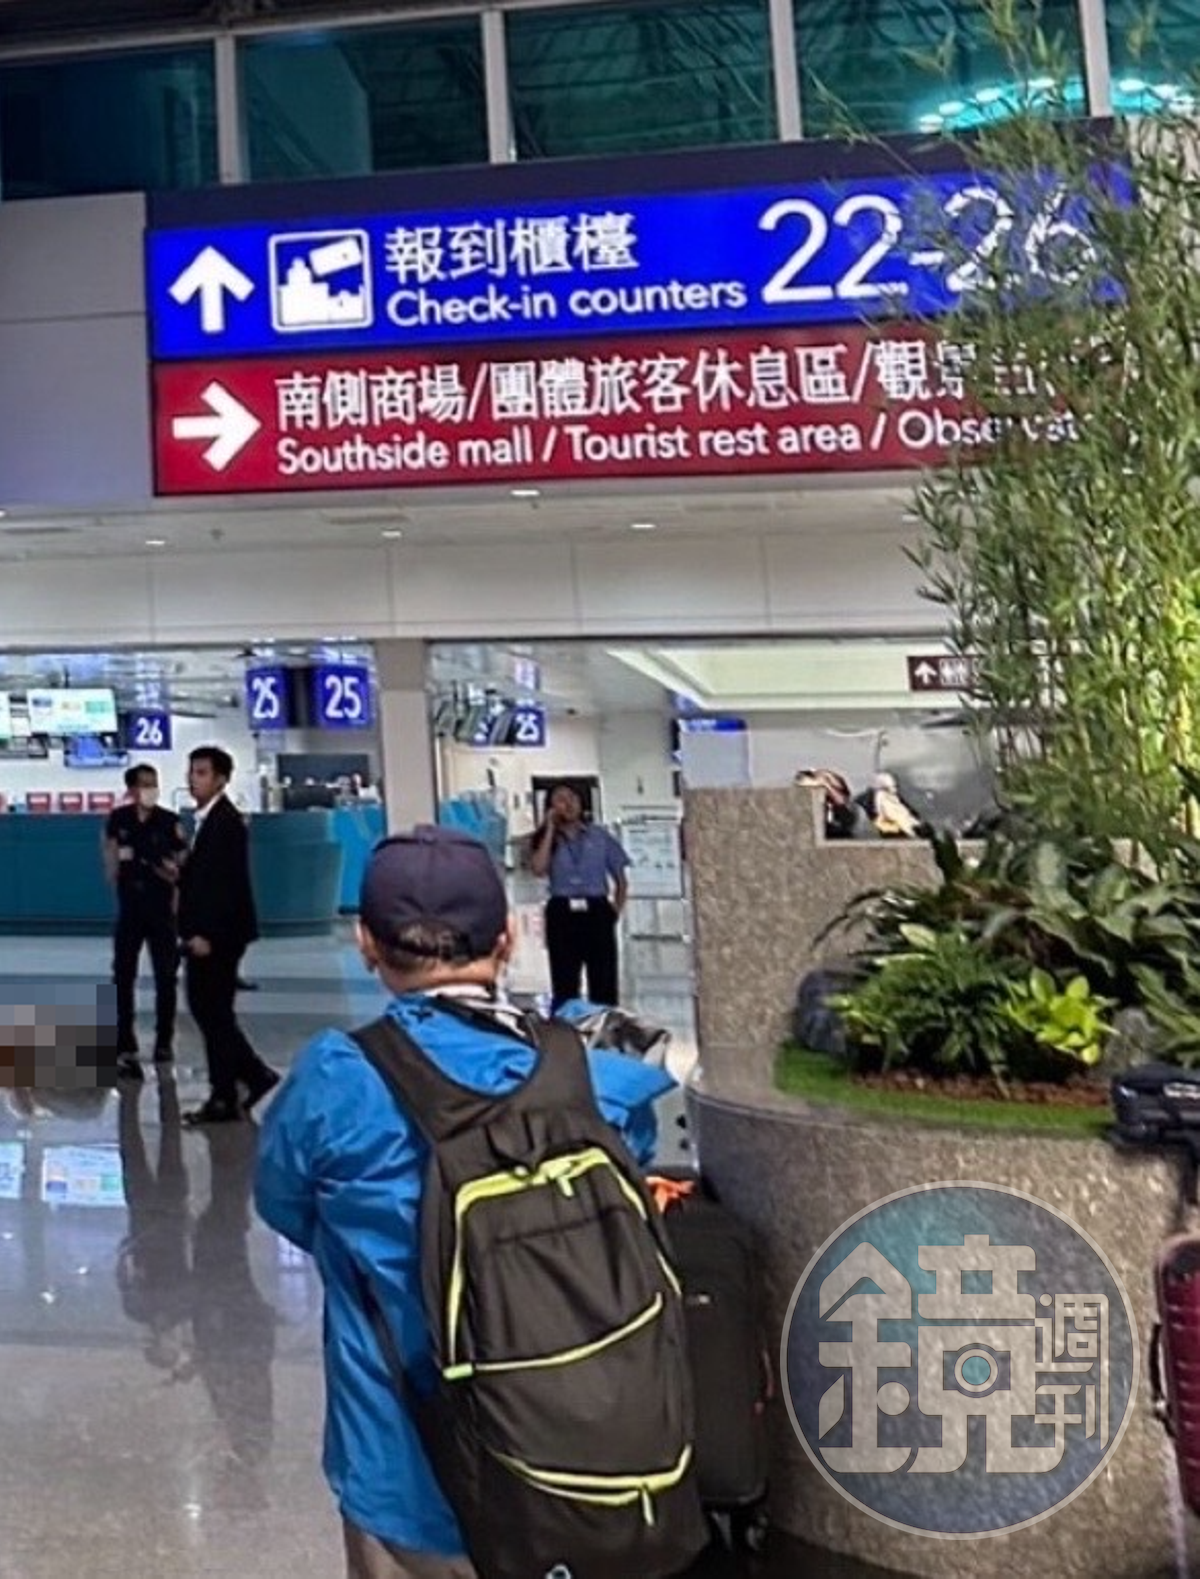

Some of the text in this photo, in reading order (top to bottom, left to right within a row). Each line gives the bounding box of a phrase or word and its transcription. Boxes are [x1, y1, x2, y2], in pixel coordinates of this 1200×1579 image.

[384, 211, 639, 285] 報到櫃檯
[758, 183, 1097, 303] 22-26
[386, 281, 748, 327] Check-in counters
[277, 431, 450, 475] Southside
[457, 425, 532, 467] mall
[563, 423, 691, 462] Tourist
[700, 422, 771, 456] rest
[778, 422, 862, 454] area
[253, 676, 280, 719] 25
[325, 675, 363, 719] 25
[136, 717, 164, 746] 26
